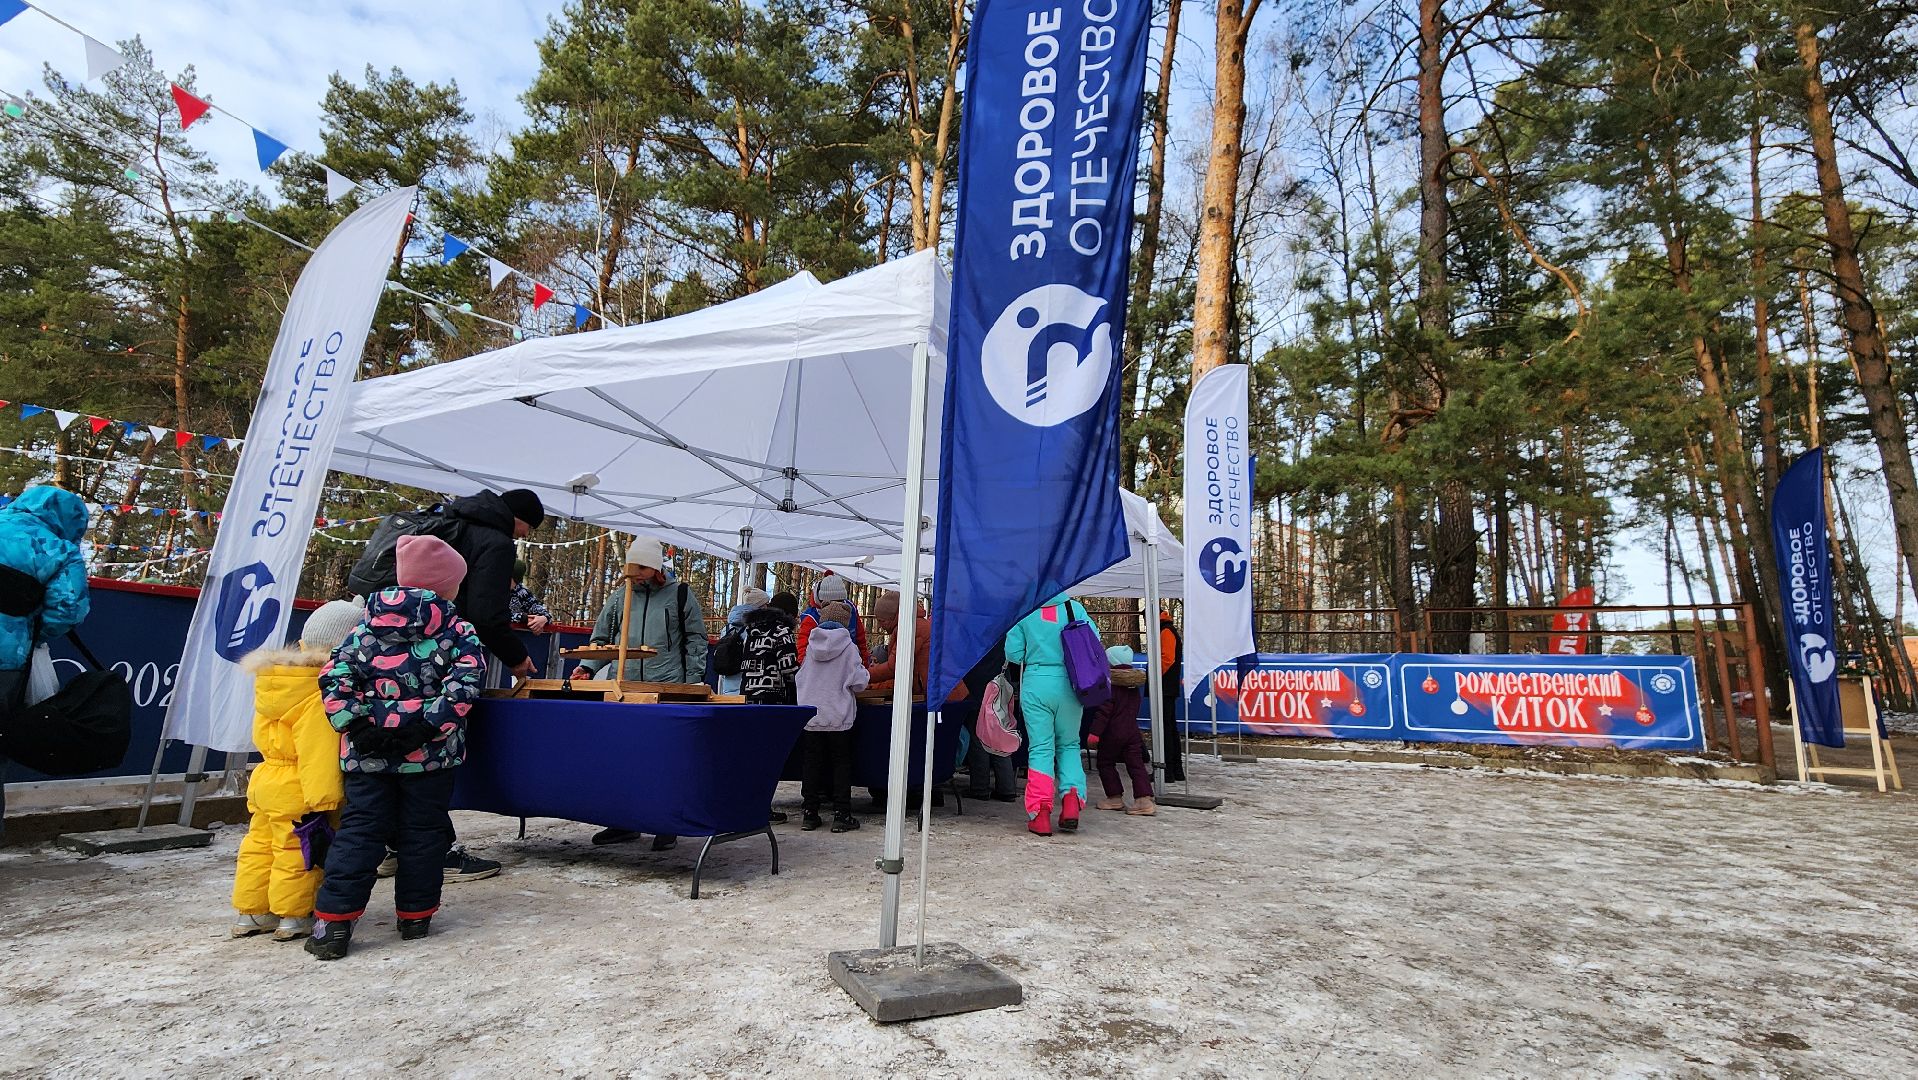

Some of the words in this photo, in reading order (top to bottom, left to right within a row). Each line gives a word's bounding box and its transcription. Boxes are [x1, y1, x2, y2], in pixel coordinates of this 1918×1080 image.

[1010, 8, 1062, 260] ЗДОРОВОЕ
[1069, 0, 1118, 256] ОТЕЧЕСТВО
[266, 331, 343, 538] ОТЕЧЕСТВО
[1206, 416, 1224, 525] ЗДОРОВОЕ
[1225, 416, 1240, 528] ОТЕЧЕСТВО
[1789, 527, 1811, 625] ЗДОРОВОЕ
[1803, 521, 1823, 625] ОТЕЧЕСТВО
[1238, 690, 1313, 719] КАТОК
[1454, 670, 1622, 697] РОЖДЕСТВЕНСКИЙ
[1490, 695, 1589, 728] КАТОК
